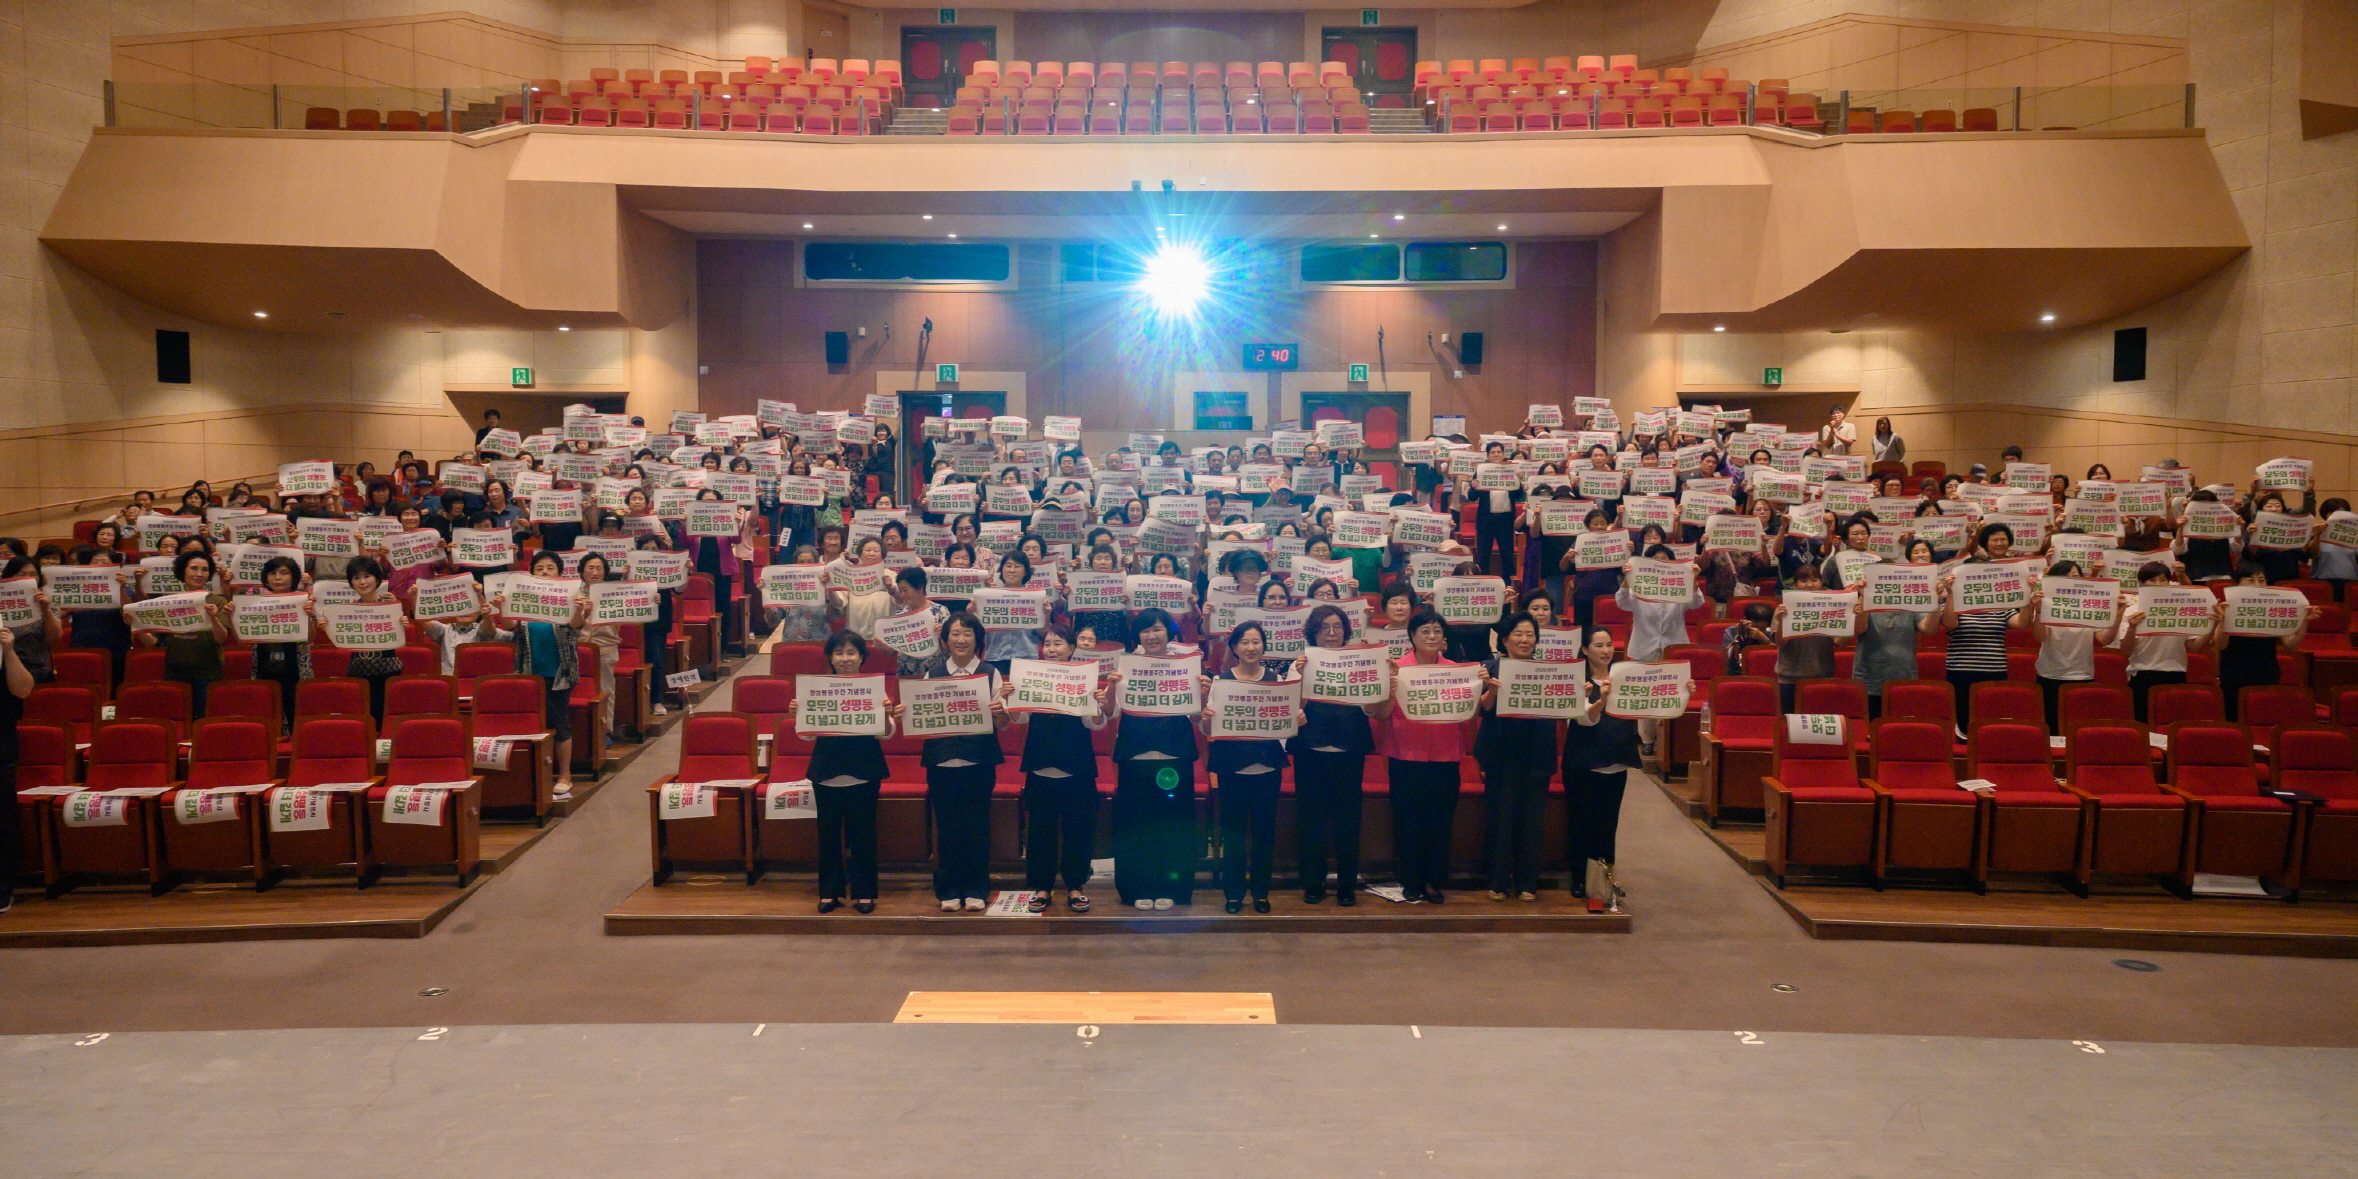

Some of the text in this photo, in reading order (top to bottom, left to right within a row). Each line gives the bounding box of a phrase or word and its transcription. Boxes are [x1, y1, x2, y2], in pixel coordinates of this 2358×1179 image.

[1272, 350, 1289, 362] 40
[54, 584, 80, 593] 모두의
[1874, 584, 1901, 594] 모두의
[1964, 583, 1992, 594] 모두의
[51, 595, 61, 605] 더
[83, 595, 92, 604] 더
[511, 592, 539, 604] 모두의
[600, 599, 623, 608] 모두의
[1444, 596, 1468, 605] 모두의
[1873, 596, 1882, 604] 더
[1904, 596, 1912, 604] 더
[1963, 596, 1973, 605] 더
[1996, 594, 2005, 603] 더
[511, 604, 520, 613] 더
[541, 606, 550, 616] 더
[599, 611, 607, 619] 더
[626, 608, 634, 616] 더
[982, 607, 1008, 616] 모두의
[1443, 608, 1451, 617] 더
[1471, 607, 1480, 616] 더
[2148, 607, 2178, 616] 모두의
[239, 614, 268, 624] 모두의
[2147, 618, 2156, 628] 더
[2178, 618, 2188, 627] 더
[240, 626, 248, 635] 더
[272, 624, 280, 634] 더
[1316, 670, 1379, 683] 모두의 성평등,
[1021, 678, 1087, 695] 모두의 성평등,
[1127, 679, 1191, 692] 모두의 성평등,
[1314, 684, 1381, 696] 더 넓고 더 깊게
[1510, 684, 1576, 696] 모두의 성평등,
[1619, 684, 1679, 697] 모두의 성평등,
[1019, 691, 1088, 707] 더 넓고 더 깊게
[1125, 693, 1192, 706] 더 넓고 더 깊게
[1407, 687, 1474, 701] 모두의 성평등,
[807, 699, 874, 712] 모두의 성평등,
[913, 700, 980, 715] 모두의 성평등,
[1407, 700, 1474, 715] 더 넓고 더 깊게
[1508, 697, 1576, 708] 더 넓고 더 깊게
[1617, 698, 1680, 710] 더 넓고 더 깊게
[1224, 705, 1291, 718] 모두의 성평등,
[806, 713, 876, 726] 더 넓고 더 깊게
[912, 714, 983, 729] 더 넓고 더 깊게
[1222, 718, 1292, 731] 더 넓고 더 깊게
[417, 1027, 448, 1040] 2
[1077, 1024, 1100, 1038] 0
[75, 1032, 110, 1046] 3
[1734, 1031, 1765, 1044] 2
[2072, 1040, 2106, 1053] 3
